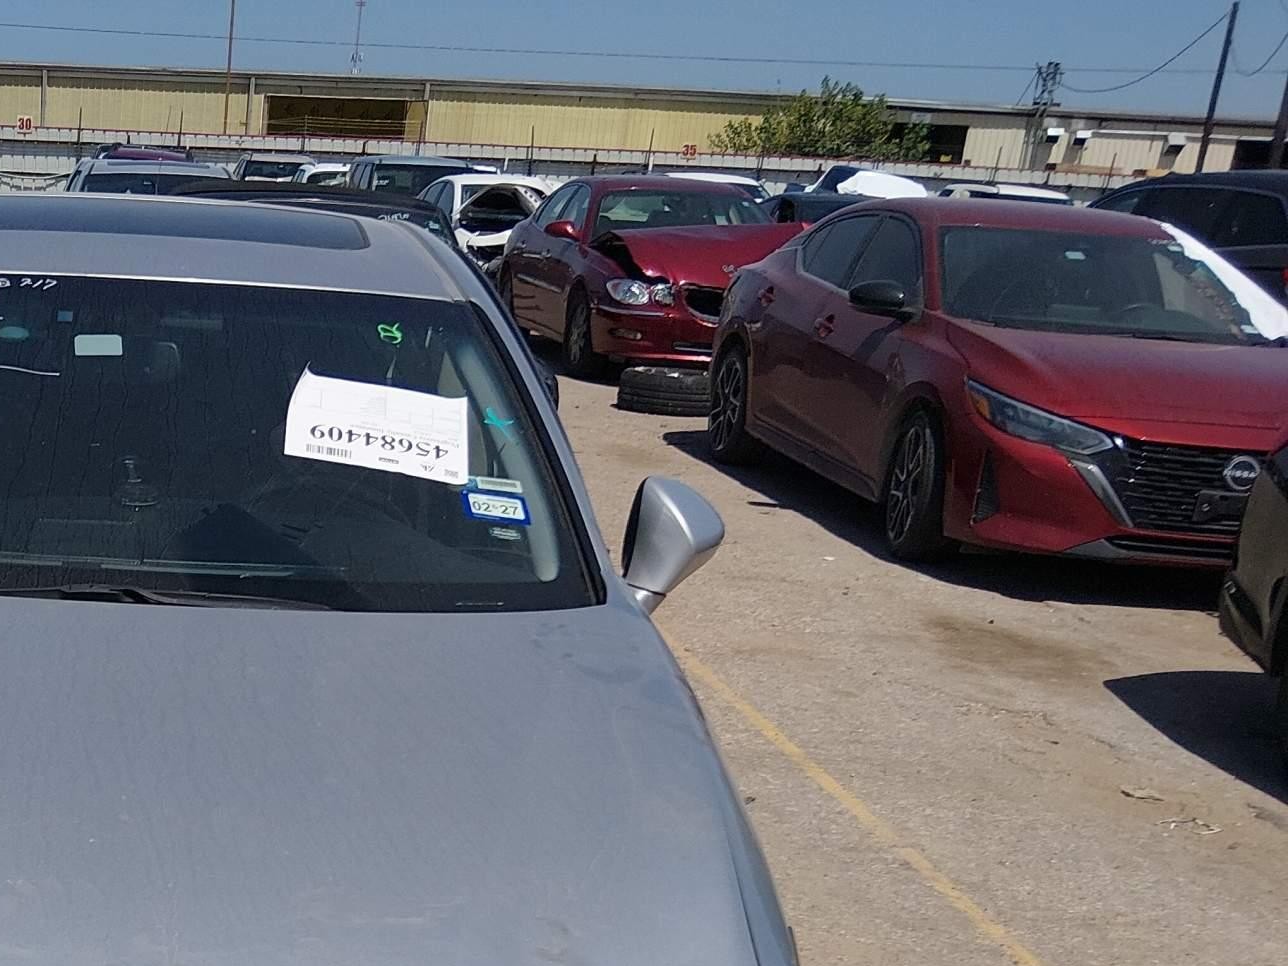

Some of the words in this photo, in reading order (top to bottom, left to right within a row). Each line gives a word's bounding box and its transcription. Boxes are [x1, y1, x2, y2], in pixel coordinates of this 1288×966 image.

[18, 117, 32, 130] 30
[682, 144, 697, 156] 35
[310, 424, 449, 460] 45684409
